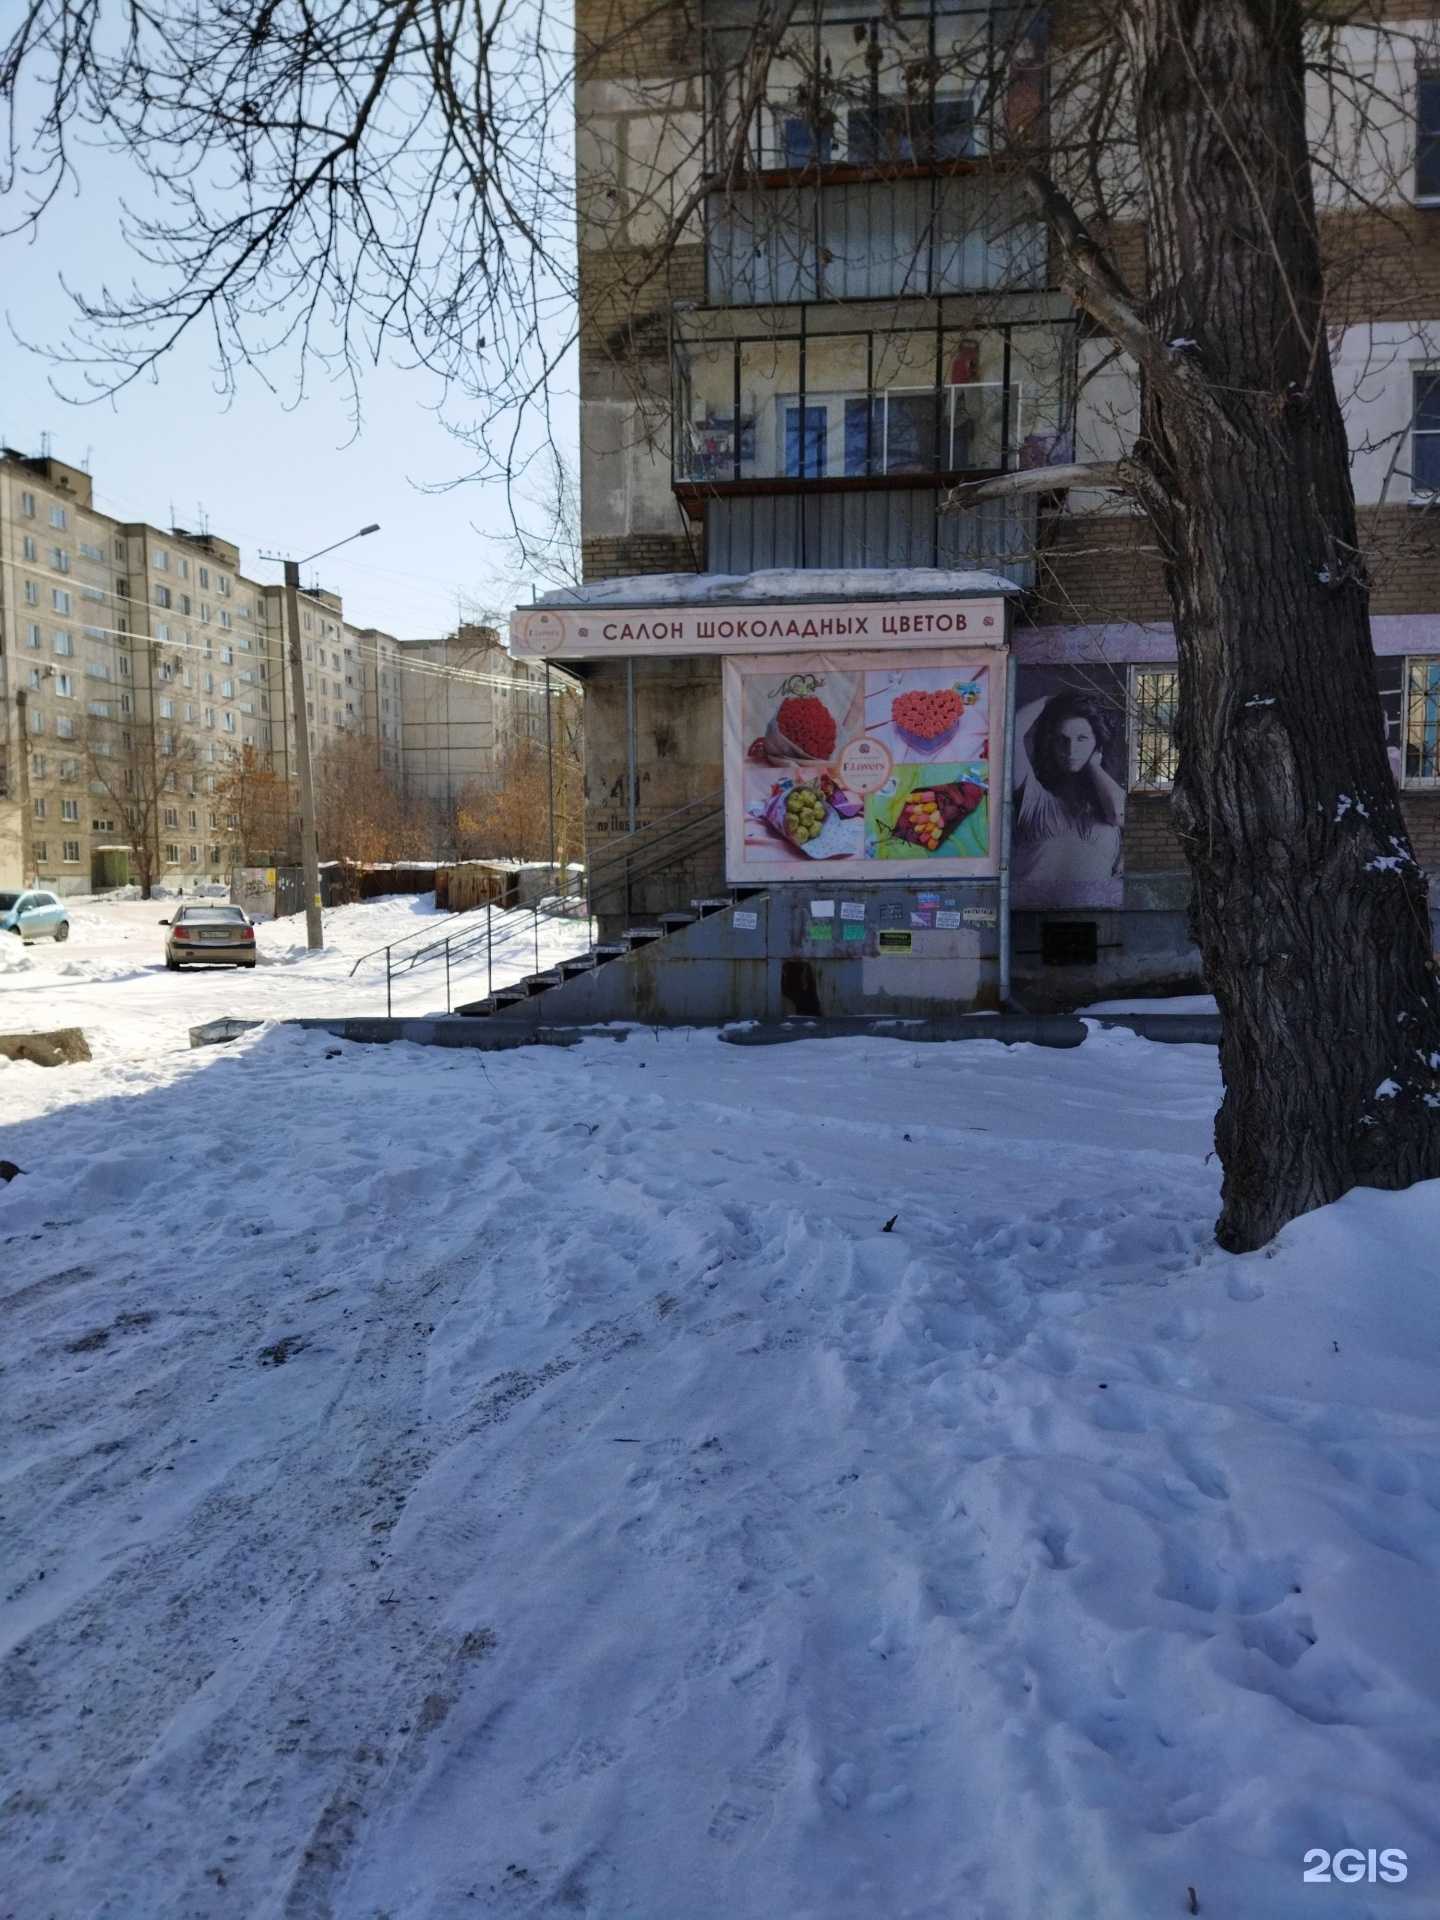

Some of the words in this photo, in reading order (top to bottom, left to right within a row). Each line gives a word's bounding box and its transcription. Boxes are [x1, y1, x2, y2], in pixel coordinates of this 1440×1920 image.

[602, 622, 684, 641] САЛОН
[696, 617, 868, 638] ШОКОЛАДНЫХ
[882, 614, 967, 635] ЦВЕТОВ
